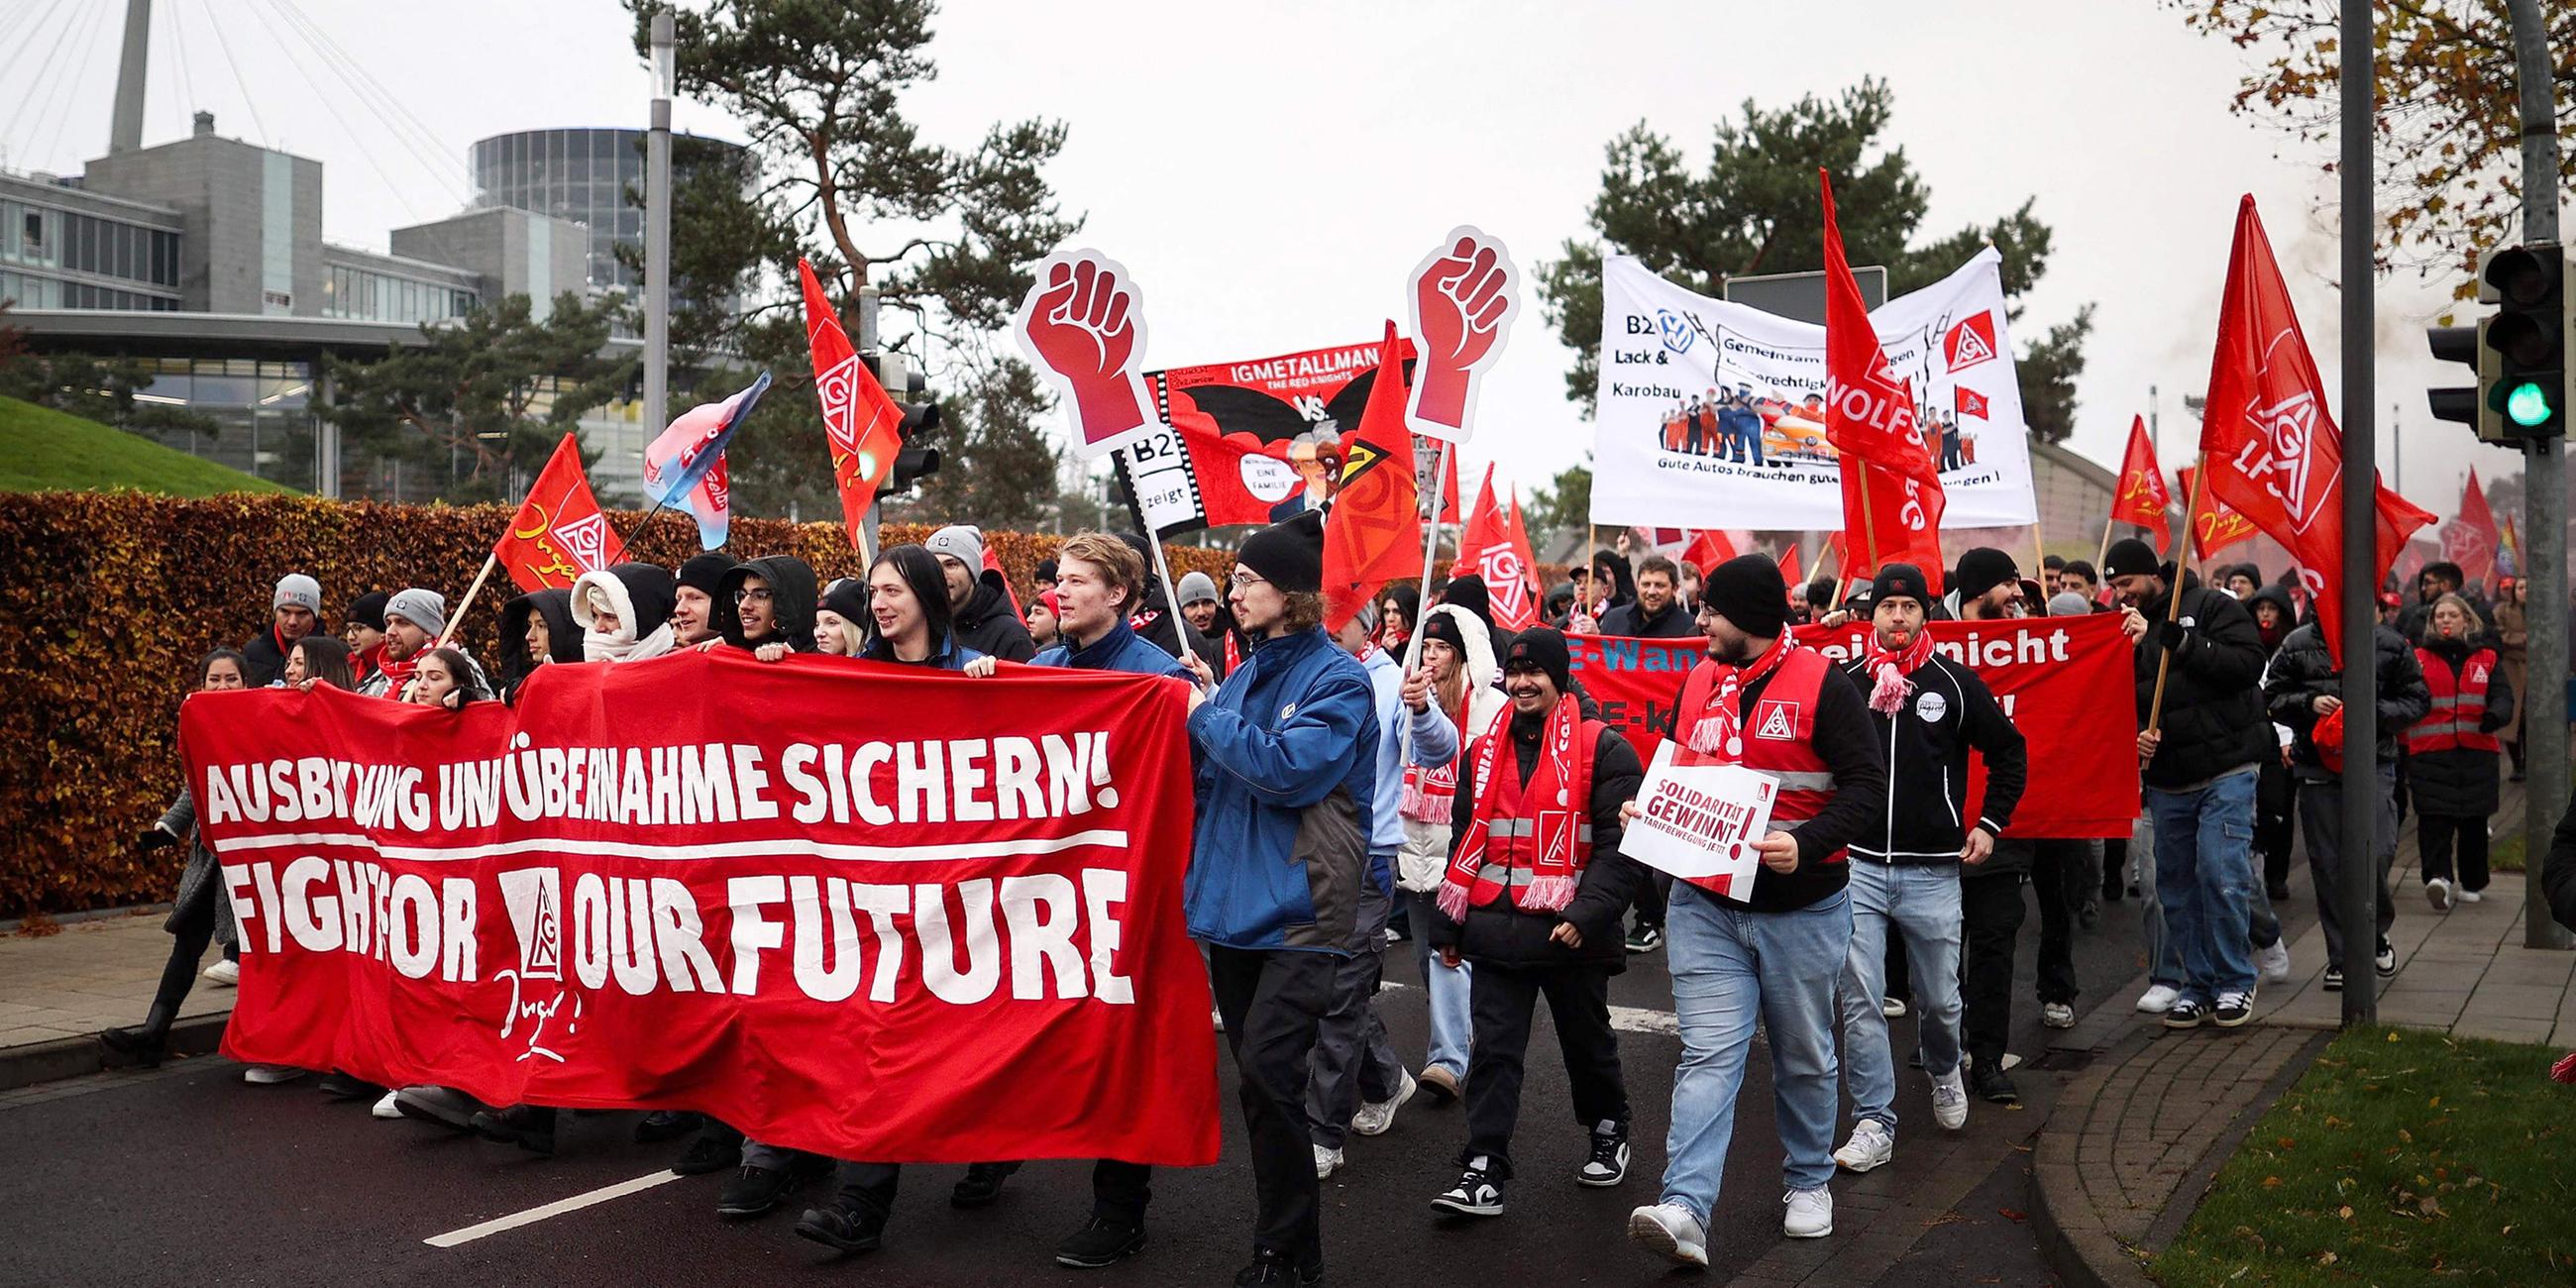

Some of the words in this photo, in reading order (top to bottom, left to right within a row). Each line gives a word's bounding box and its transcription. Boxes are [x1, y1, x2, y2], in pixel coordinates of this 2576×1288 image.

[1627, 315, 1656, 335] B2
[1615, 350, 1652, 365] Lack
[1656, 351, 1669, 366] &
[1724, 338, 1819, 364] Gemeinsam
[1232, 347, 1380, 383] IGMETALLMAN
[1267, 379, 1288, 390] THE
[1288, 377, 1310, 388] RED
[1310, 371, 1354, 385] KNIGHTS
[1613, 382, 1681, 399] Karobau
[1132, 433, 1175, 463] B2
[1256, 468, 1277, 478] EINE
[1658, 458, 1690, 471] Gute
[1693, 461, 1734, 476] Autos
[1737, 467, 1806, 483] brauchen
[1252, 481, 1287, 489] FAMILIE
[1146, 487, 1185, 509] zeigt
[1936, 628, 2070, 667] nicht
[503, 731, 780, 825] ÜBERNAHME
[783, 731, 1120, 827] SICHERN!
[1656, 778, 1745, 821] SOLIDARITÄT
[1643, 815, 1707, 848] TARIFBEWEGUNG
[573, 872, 726, 995] OUR
[727, 868, 1135, 1005] FUTURE
